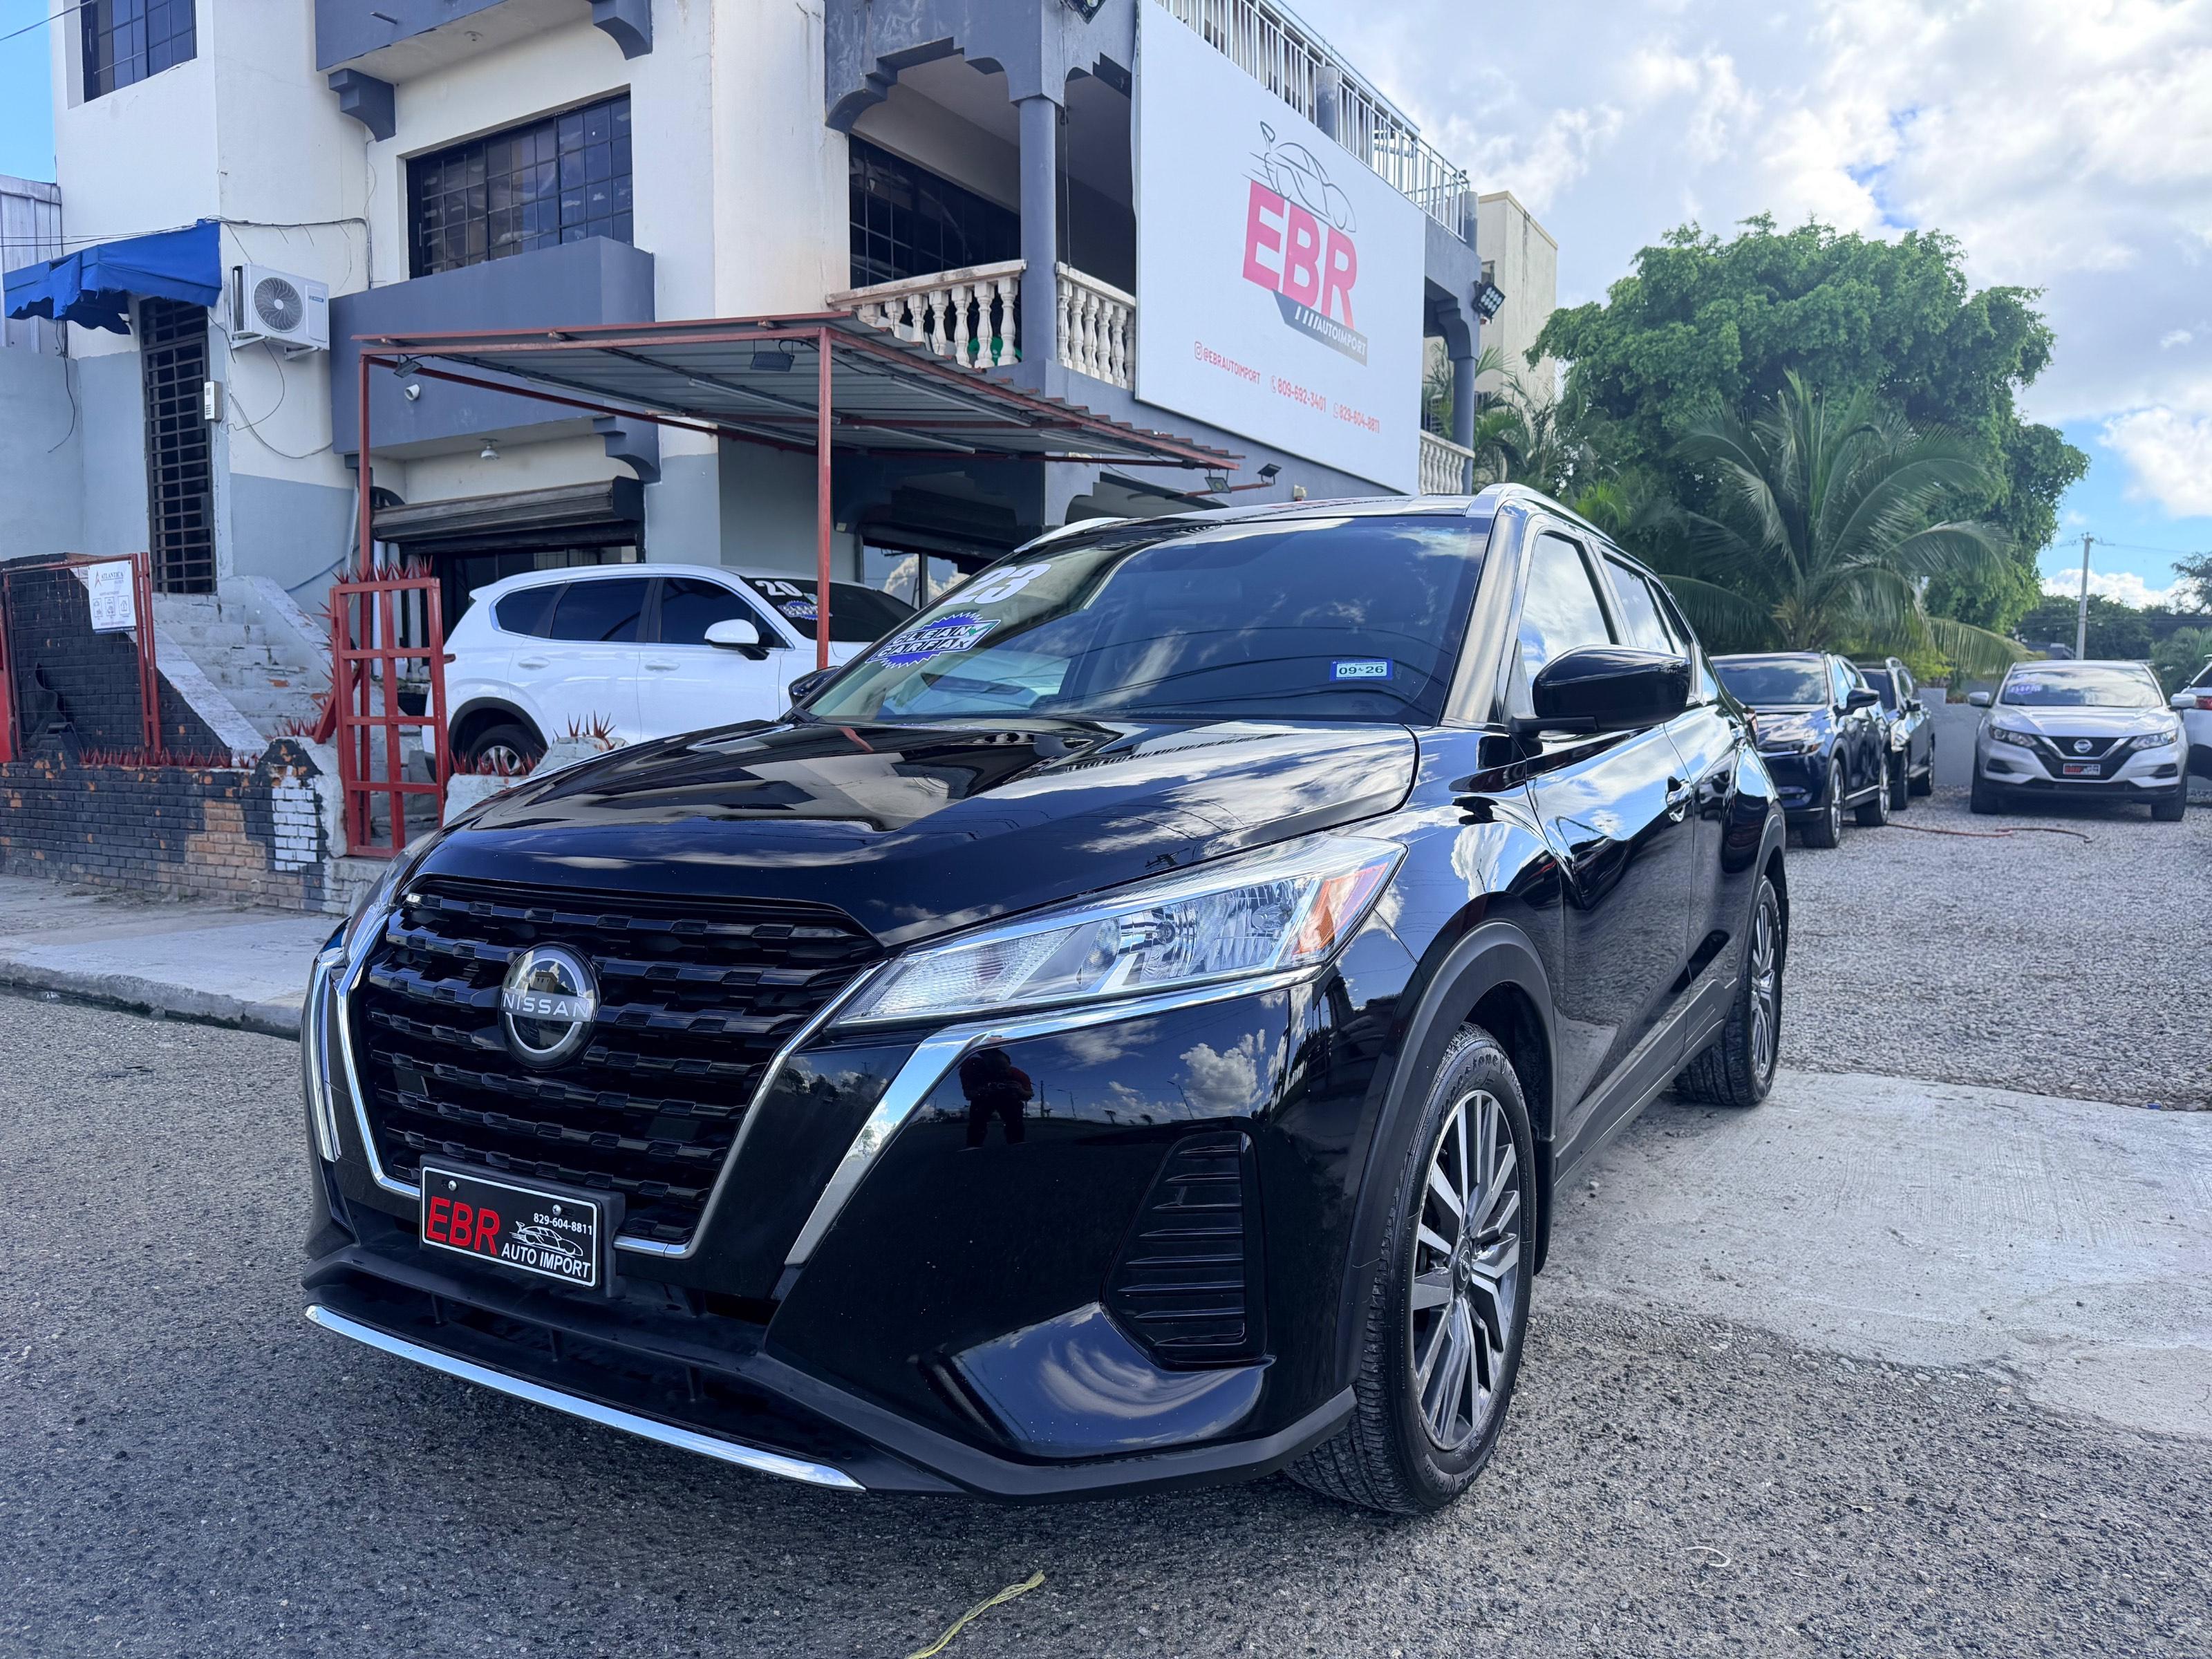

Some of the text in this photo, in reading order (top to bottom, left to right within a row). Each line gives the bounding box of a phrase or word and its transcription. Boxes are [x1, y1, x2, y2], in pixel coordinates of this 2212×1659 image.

[1242, 180, 1358, 330] EBR
[1277, 378, 1326, 412] 809-692-3401
[755, 580, 803, 597] 20
[938, 563, 1051, 607] 23
[877, 637, 971, 657] CARFAX
[892, 626, 973, 644] CLEAN
[503, 993, 590, 1018] NISSAN
[427, 1196, 500, 1255] EBR
[533, 1212, 593, 1236] 829-604-8811
[501, 1242, 591, 1278] AUTO IMPORT
